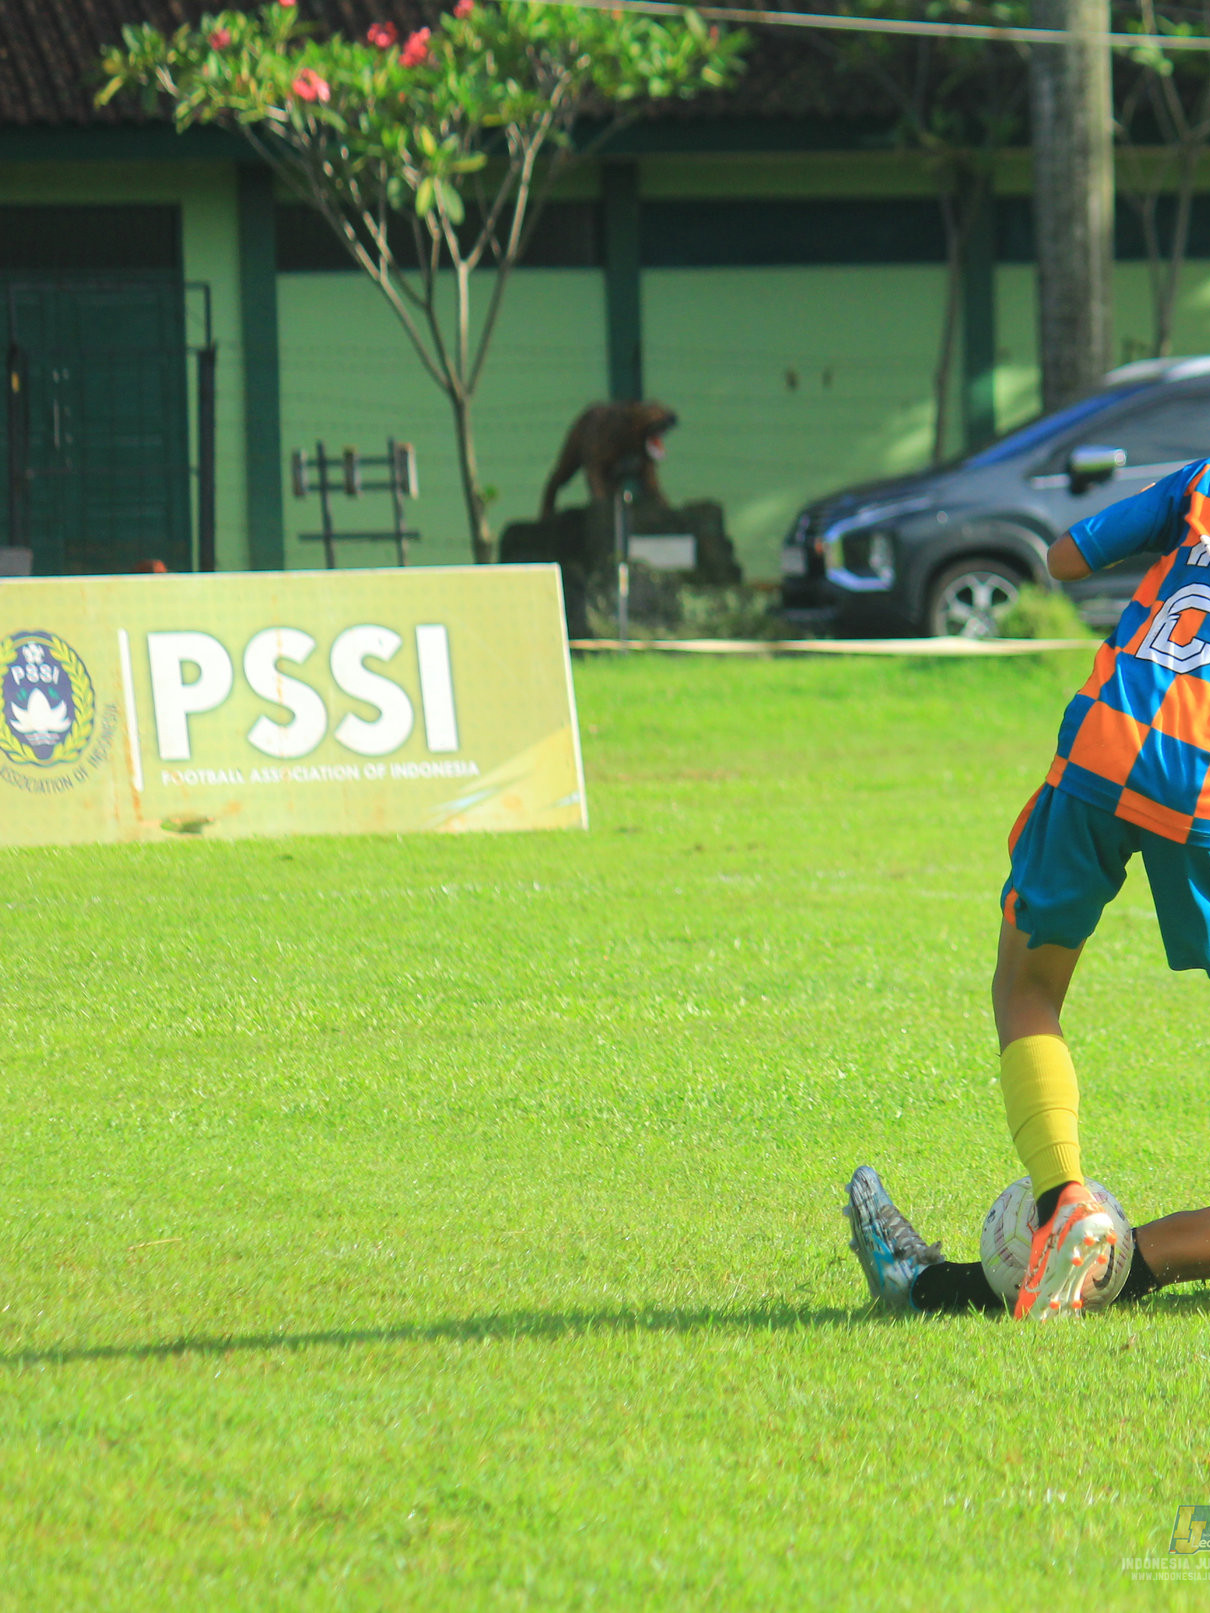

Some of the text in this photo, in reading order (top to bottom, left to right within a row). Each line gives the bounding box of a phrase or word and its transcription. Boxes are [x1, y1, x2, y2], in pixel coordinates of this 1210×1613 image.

[11, 663, 59, 685] PSSI
[147, 624, 459, 760] PSSI
[161, 760, 480, 786] FOOTBALL ASSOCIATION OF INDONESIA
